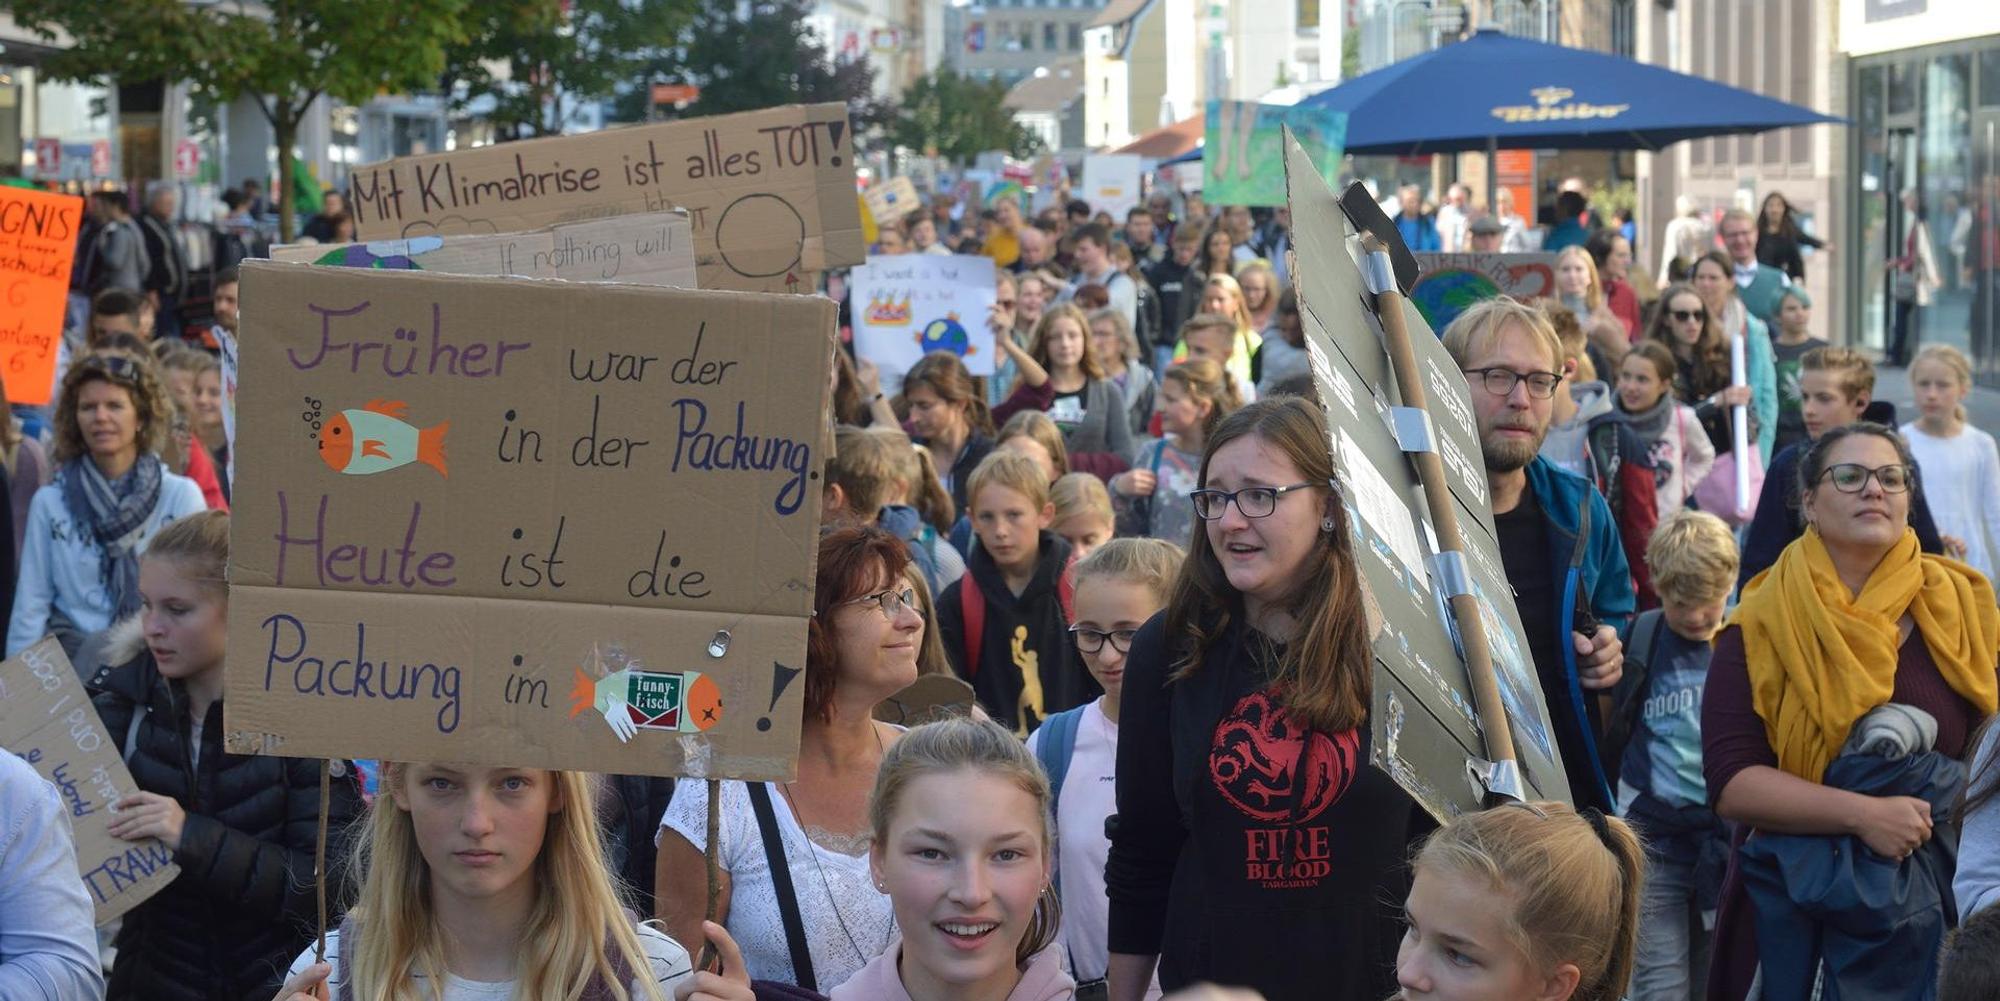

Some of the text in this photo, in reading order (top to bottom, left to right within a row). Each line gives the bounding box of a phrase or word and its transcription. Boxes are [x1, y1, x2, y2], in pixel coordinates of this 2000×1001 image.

[352, 121, 845, 223] Mit Klimakrise ist alles TOT!
[533, 237, 620, 278] nothing
[635, 226, 671, 257] will
[286, 301, 531, 378] Früher
[569, 321, 738, 385] war der
[498, 394, 819, 516] in der Packung.
[274, 490, 712, 598] Heute ist die
[261, 613, 460, 734] Packung
[504, 654, 549, 709] im
[636, 676, 675, 697] funny-
[1247, 861, 1331, 881] BLOOD
[1262, 880, 1319, 890] TARGARYEN
